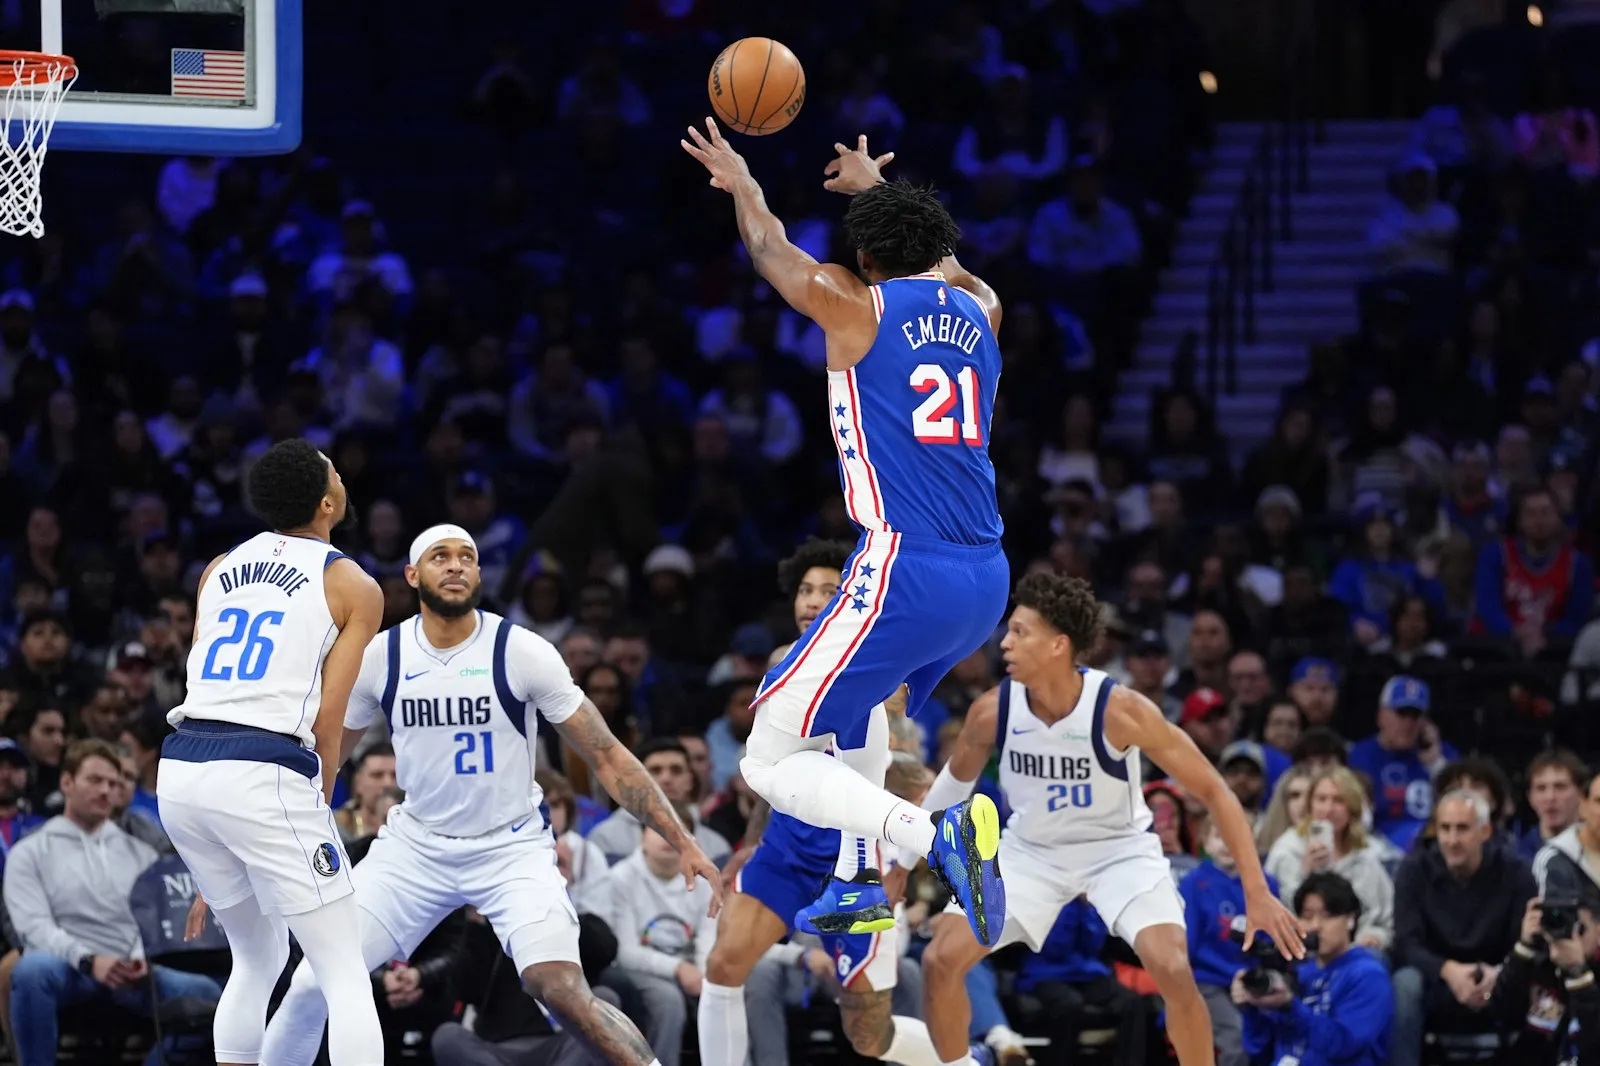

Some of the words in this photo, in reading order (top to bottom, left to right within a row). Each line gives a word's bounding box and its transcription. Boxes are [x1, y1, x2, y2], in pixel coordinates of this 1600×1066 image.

[902, 314, 981, 355] EMBIID
[909, 364, 982, 447] 21
[219, 562, 309, 598] DINWIDDIE
[201, 608, 286, 680] 26
[460, 667, 489, 677] chime
[401, 696, 491, 728] DALLAS
[454, 731, 494, 775] 21
[1009, 750, 1090, 780] DALLAS
[1047, 783, 1092, 813] 20
